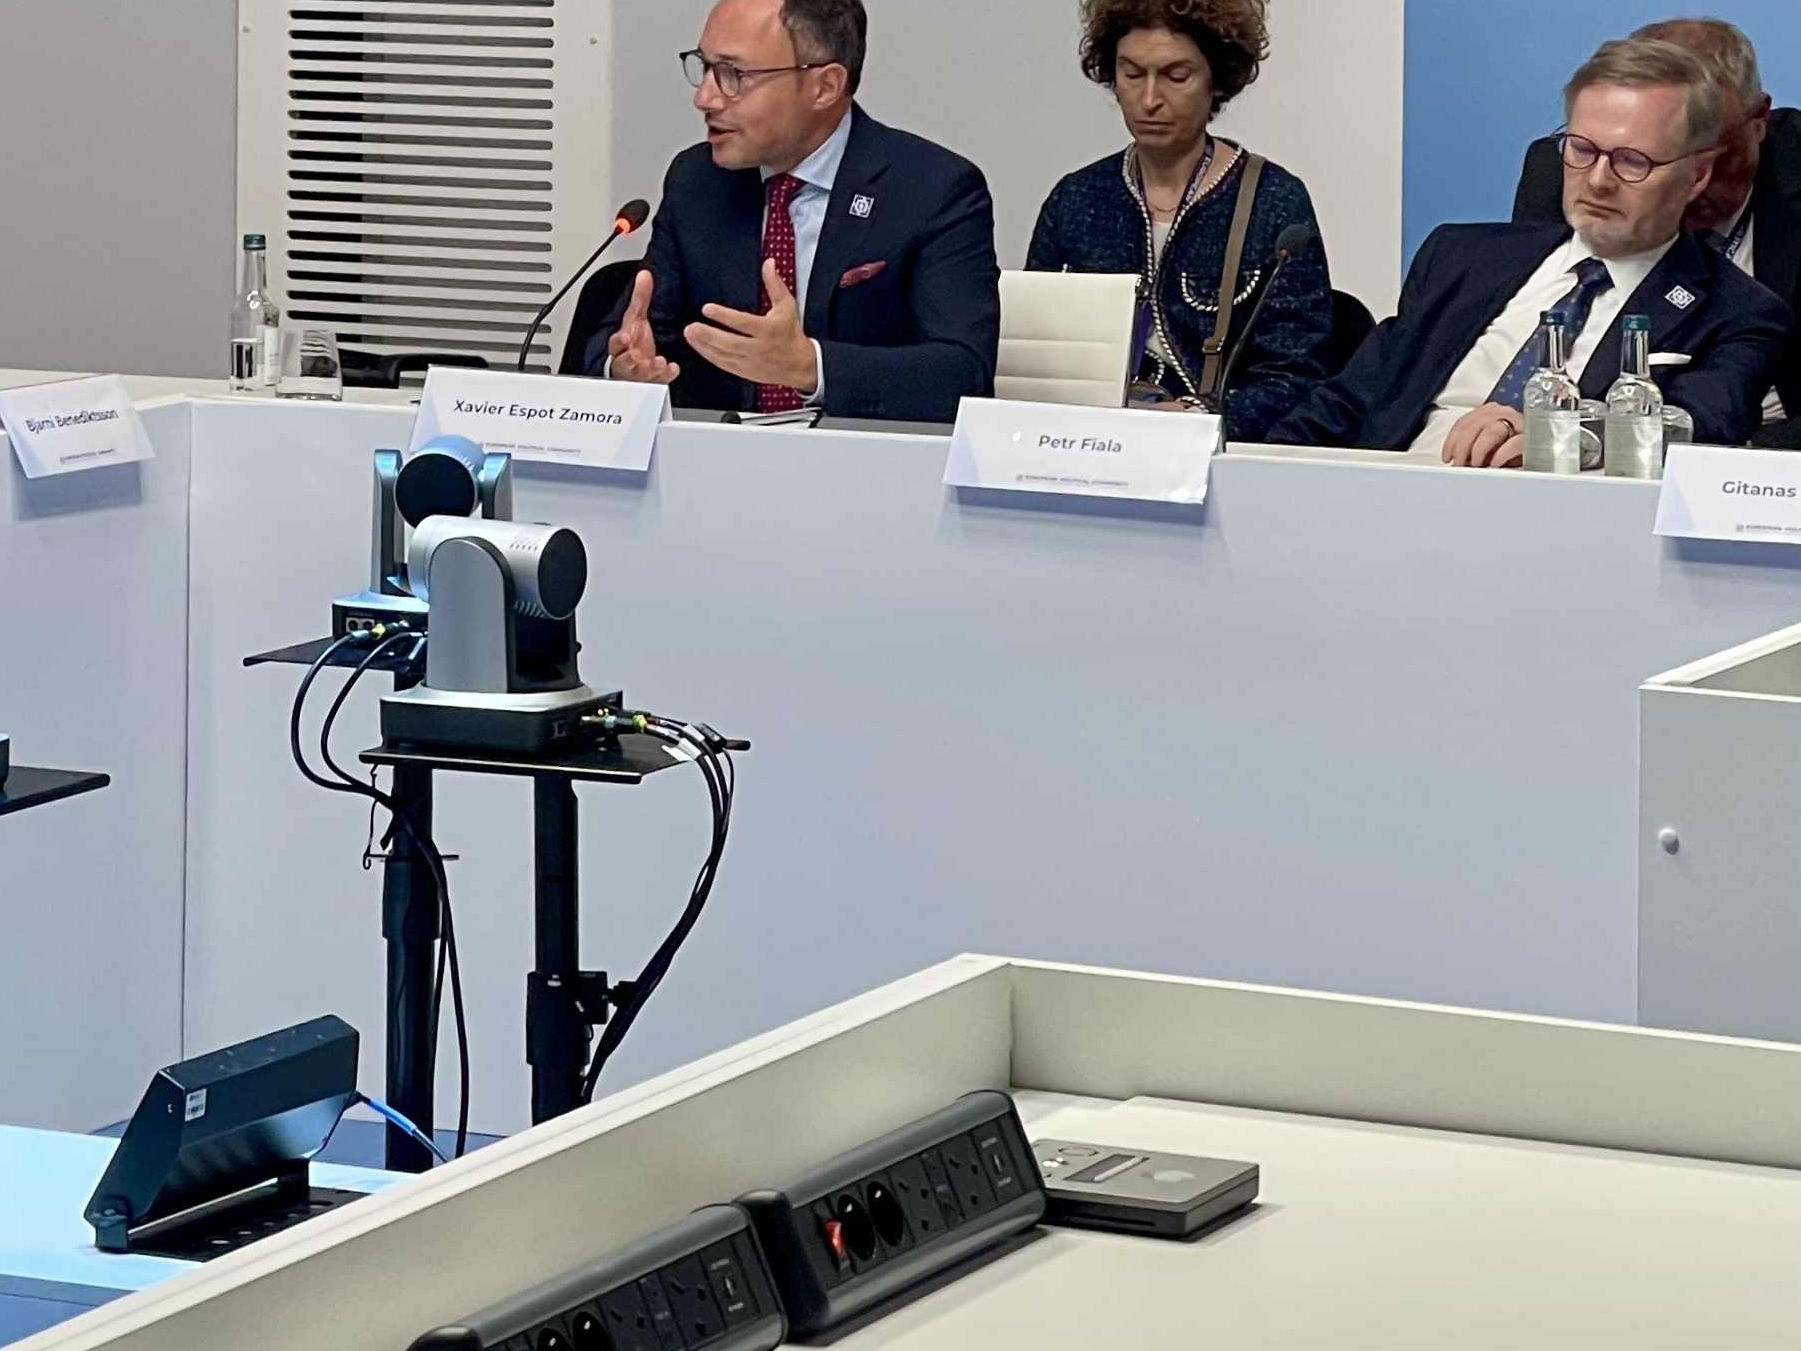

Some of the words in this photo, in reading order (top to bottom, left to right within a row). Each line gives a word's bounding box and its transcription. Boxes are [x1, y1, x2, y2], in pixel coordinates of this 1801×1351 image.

[453, 399, 505, 415] Xavier
[509, 403, 555, 421] Espot
[560, 407, 623, 425] Zamora
[1038, 434, 1077, 450] Petr
[1081, 437, 1123, 454] Fiala
[1721, 480, 1797, 498] Gitanas
